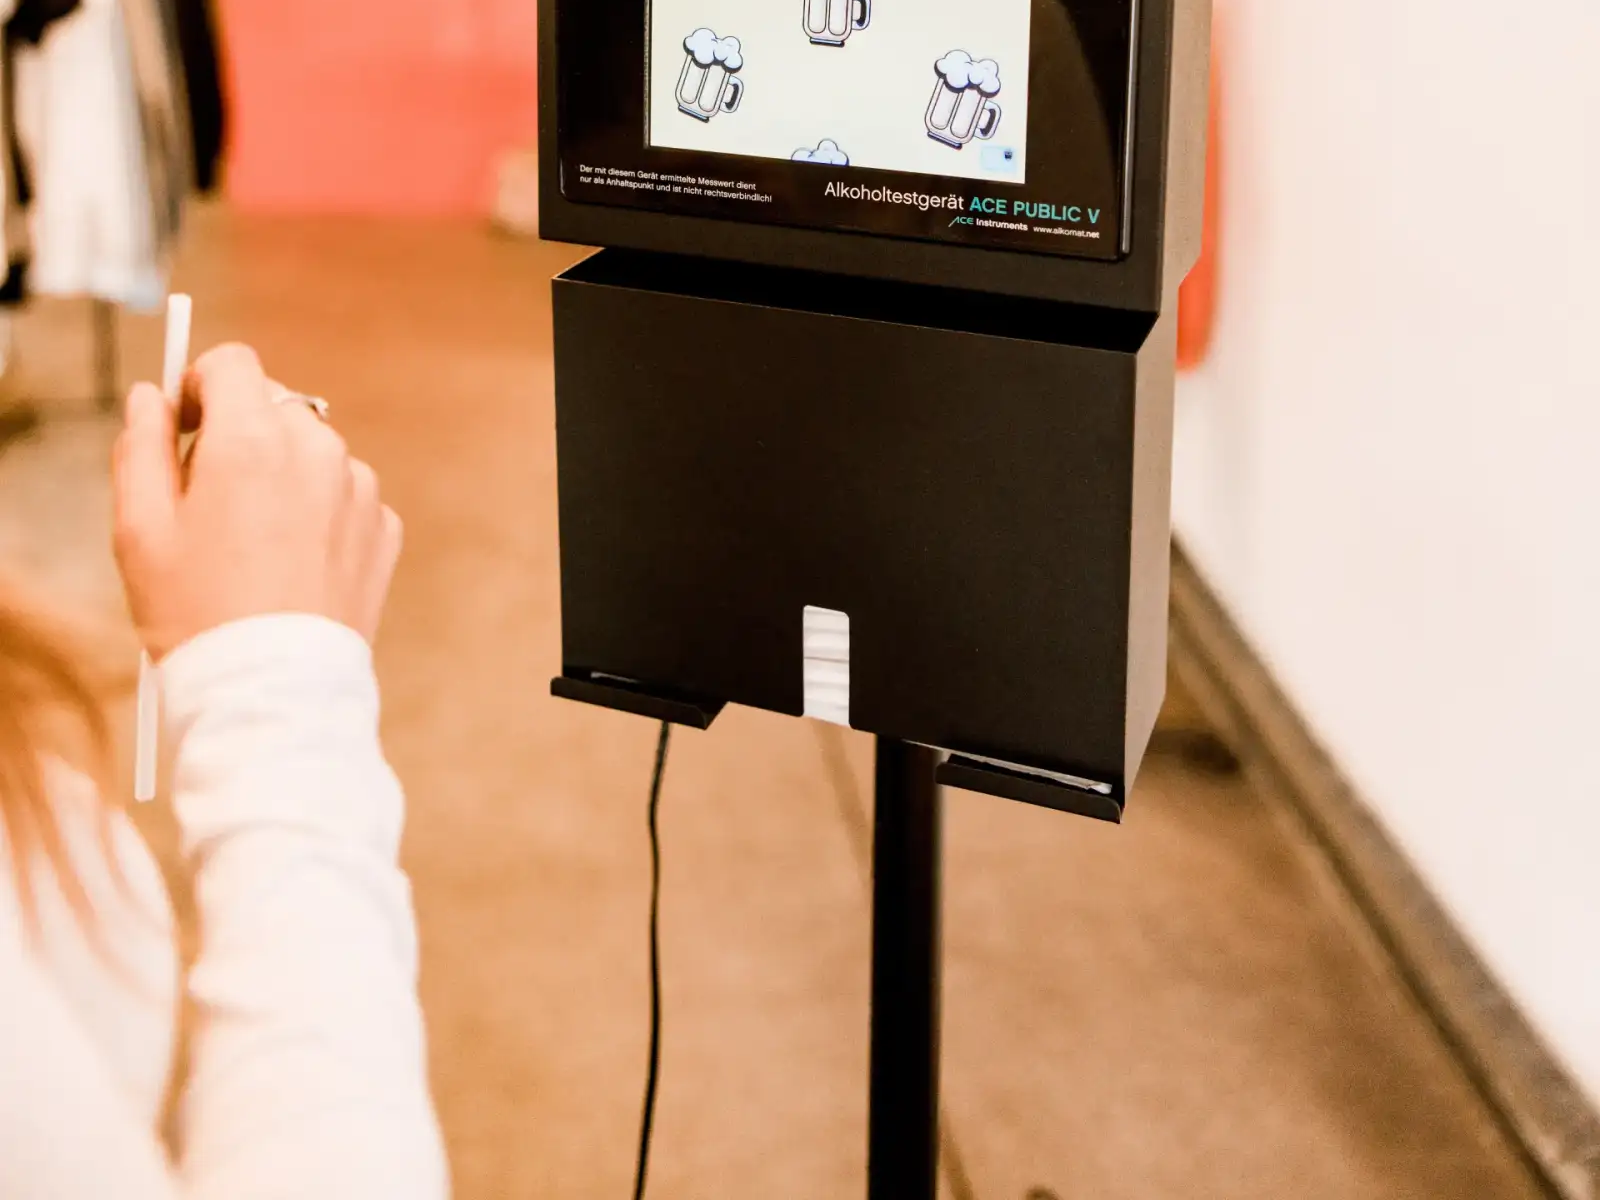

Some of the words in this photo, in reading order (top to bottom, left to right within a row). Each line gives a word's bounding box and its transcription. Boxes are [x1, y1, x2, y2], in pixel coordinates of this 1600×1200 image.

[580, 164, 592, 173] Der
[595, 166, 606, 175] mit
[608, 167, 635, 177] diesem
[637, 170, 658, 180] Gerät
[660, 174, 696, 184] ermittelte
[698, 177, 734, 188] Messwert
[737, 181, 756, 190] dient
[594, 176, 604, 184] als
[606, 178, 654, 190] Anhaltspunkt
[656, 183, 671, 192] und
[673, 184, 682, 193] ist
[683, 186, 702, 195] nicht
[824, 182, 964, 210] Alkoholtestgerät
[969, 196, 1007, 215] ACE
[1014, 201, 1081, 222] PUBLIC
[1088, 208, 1100, 224] V
[948, 216, 974, 228] ACE
[976, 218, 1028, 231] Instruments
[1033, 226, 1100, 238] www.alkomat.net
